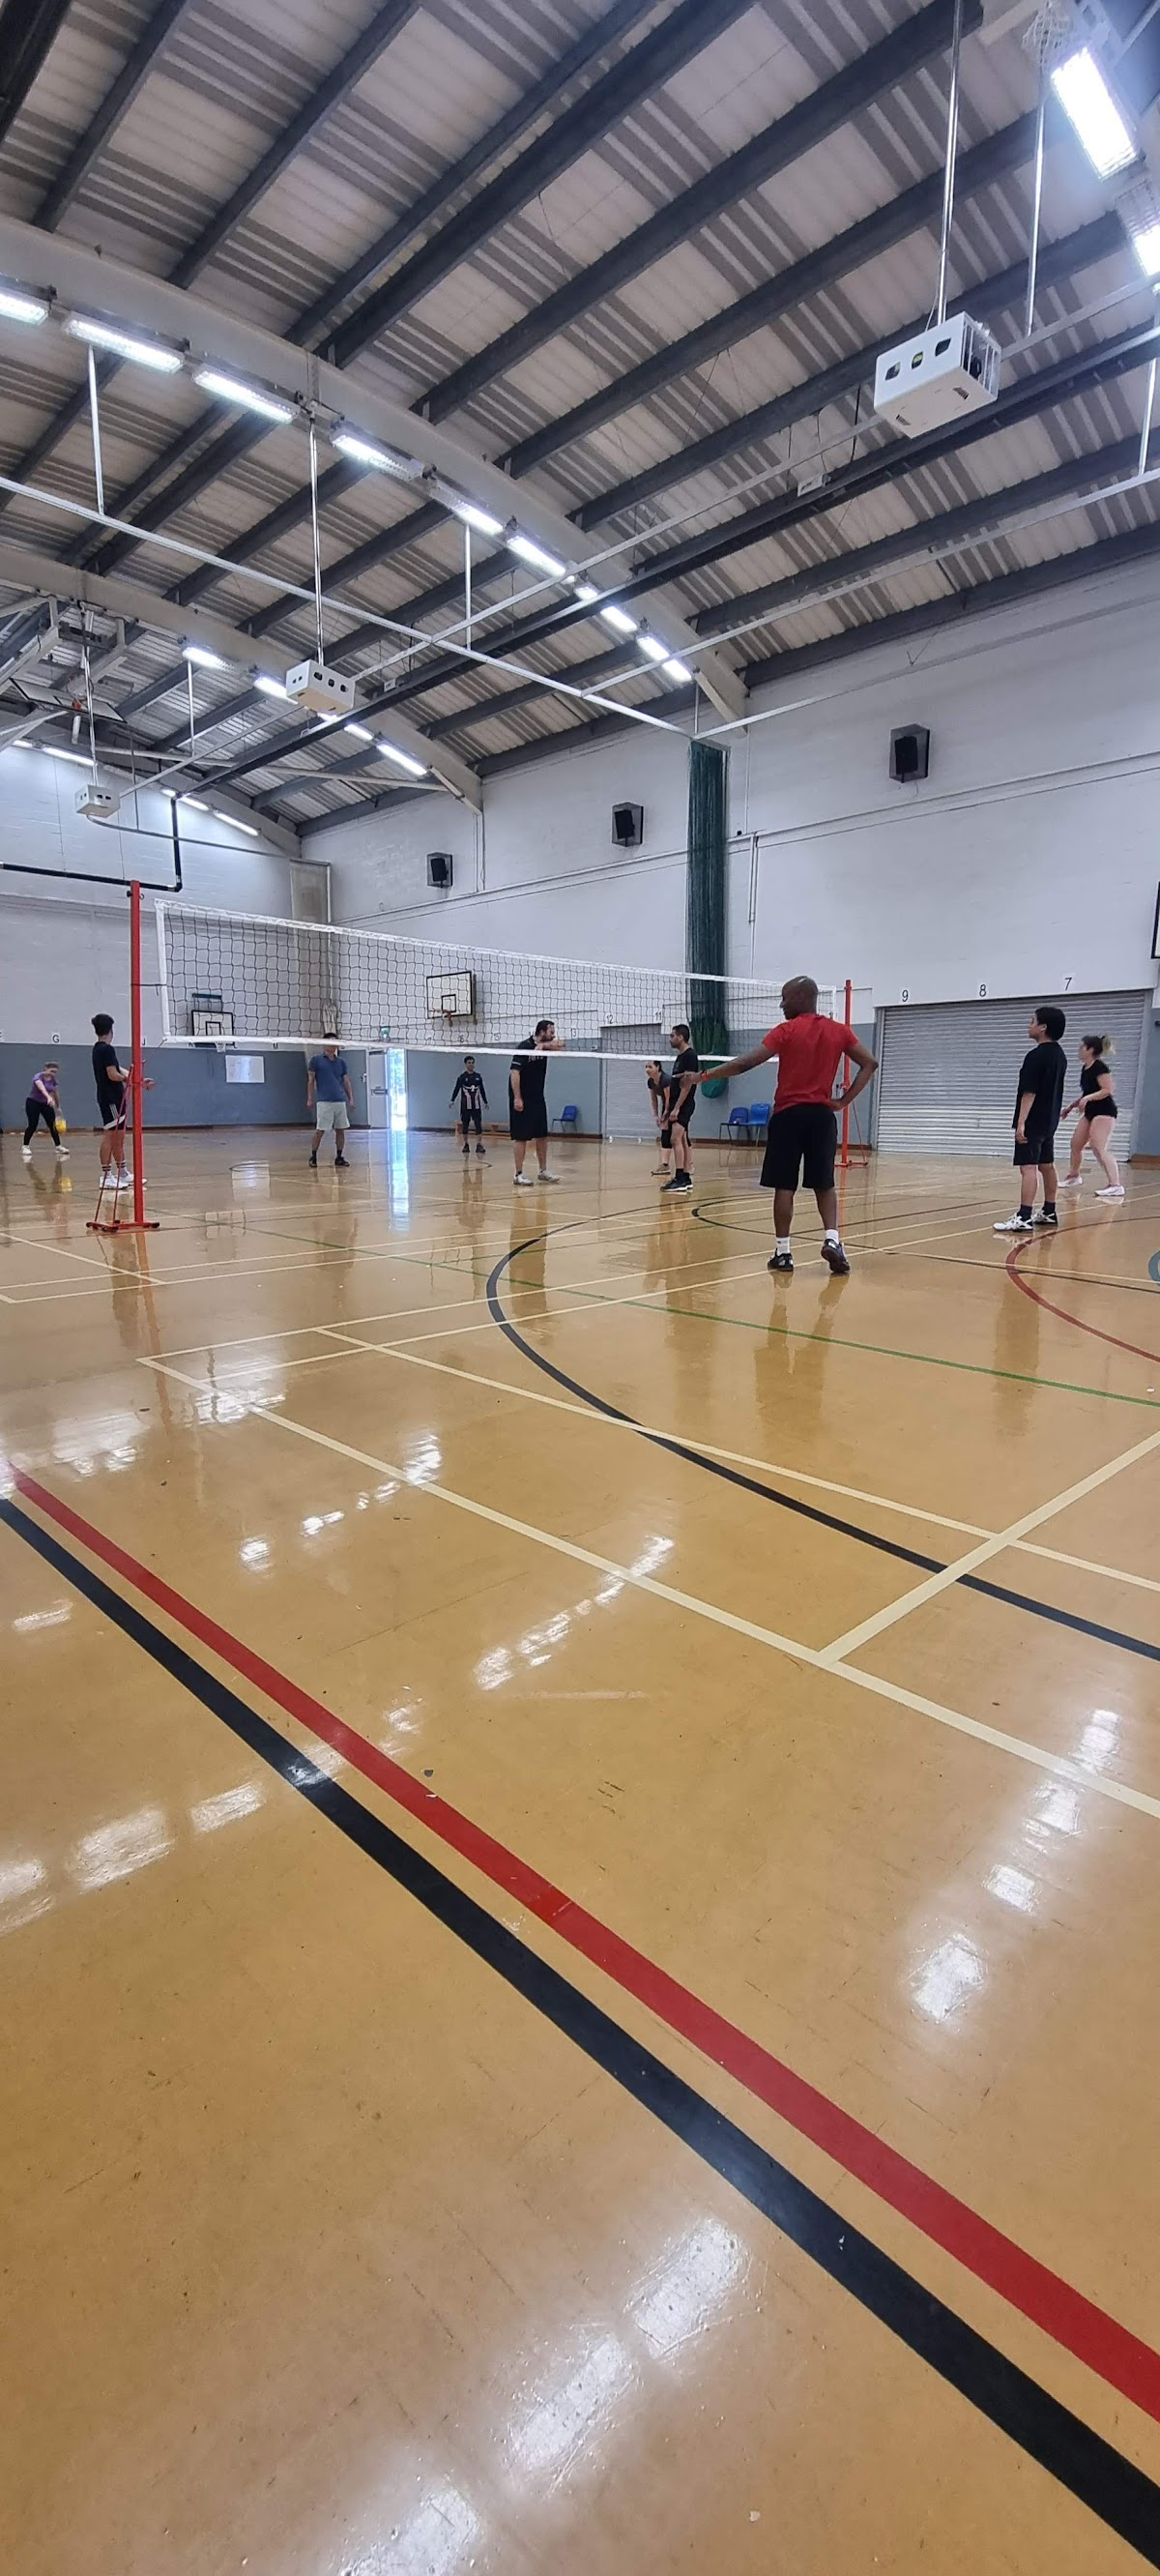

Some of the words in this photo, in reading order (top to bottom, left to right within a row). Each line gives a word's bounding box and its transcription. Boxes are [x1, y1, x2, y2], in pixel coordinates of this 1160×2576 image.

[979, 983, 987, 997] 8
[1064, 977, 1073, 991] 7
[902, 989, 909, 1003] 9
[606, 1013, 614, 1024] 12
[52, 1034, 60, 1043] G
